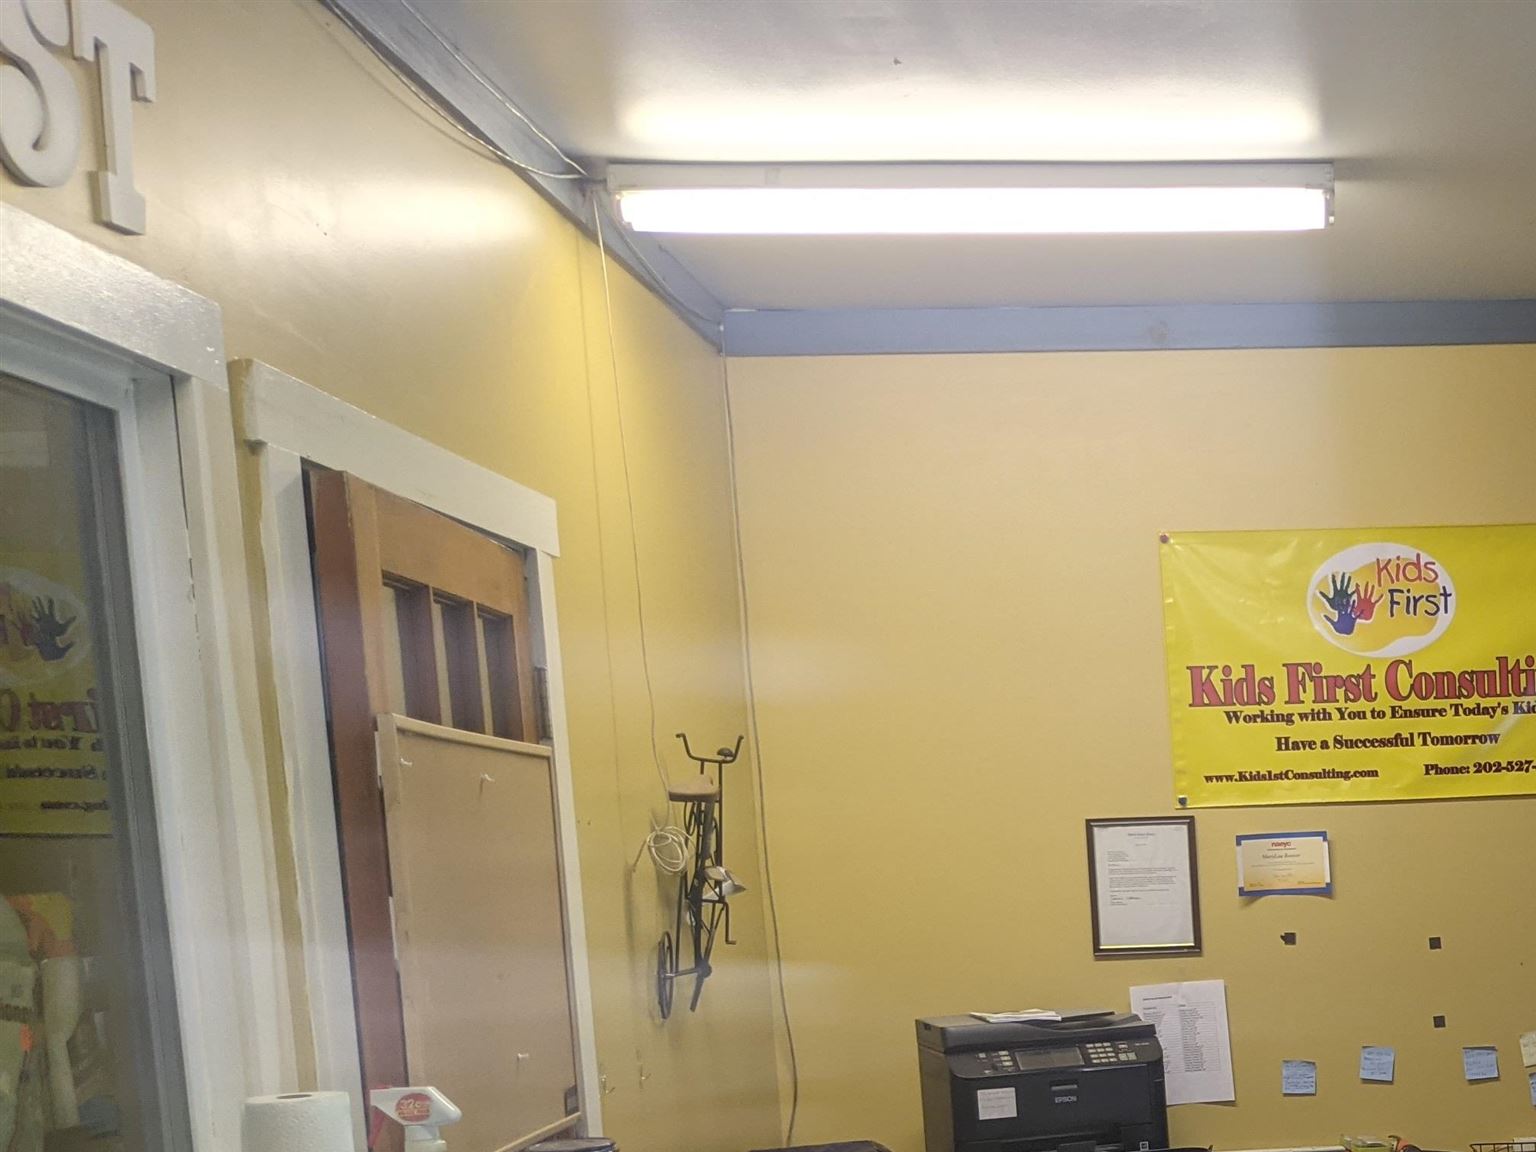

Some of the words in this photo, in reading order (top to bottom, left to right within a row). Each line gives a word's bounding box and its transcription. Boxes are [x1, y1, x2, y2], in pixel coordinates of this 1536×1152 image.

[1376, 552, 1439, 587] Kids
[1388, 585, 1452, 618] First
[1186, 664, 1276, 707] Kids
[1282, 662, 1378, 704] First
[1224, 709, 1295, 726] Working
[1298, 708, 1332, 722] with
[1335, 706, 1367, 721] You
[1371, 707, 1386, 720] to
[1389, 704, 1447, 720] Ensure
[1450, 702, 1509, 719] Today's
[1275, 736, 1317, 751] Have
[1320, 739, 1330, 750] a
[1333, 732, 1415, 750] Successful
[1418, 731, 1500, 747] Tomorrow
[1204, 768, 1379, 784] www.Kids1stConsulting.com
[1424, 762, 1470, 776] Phone:
